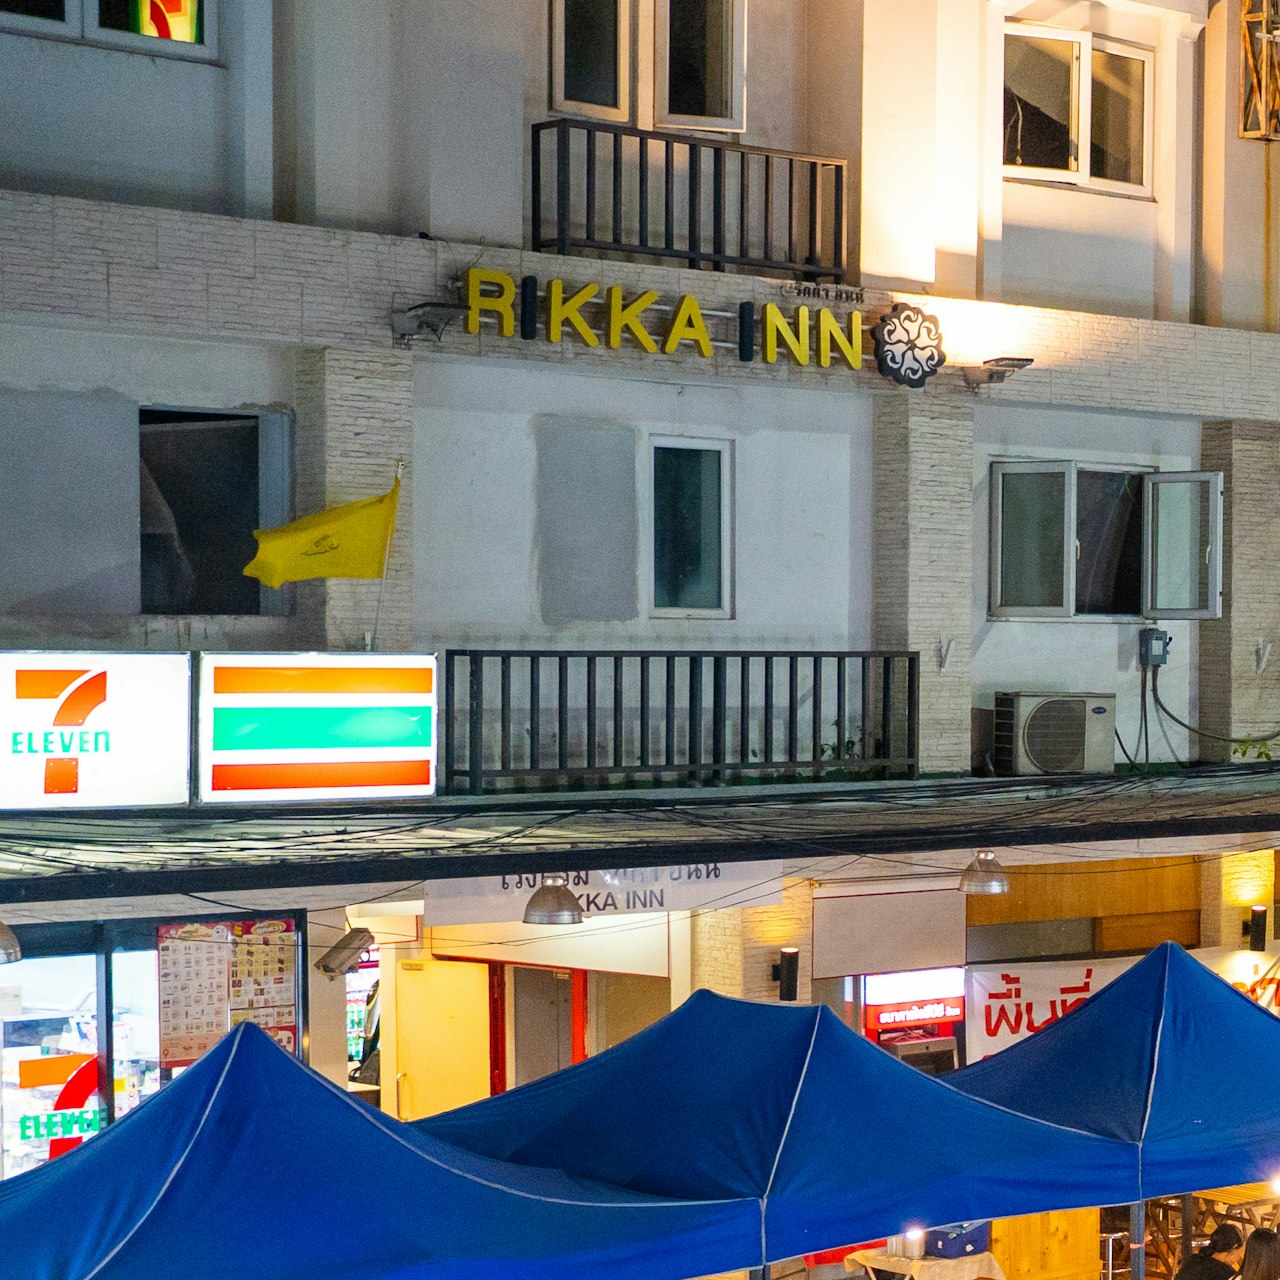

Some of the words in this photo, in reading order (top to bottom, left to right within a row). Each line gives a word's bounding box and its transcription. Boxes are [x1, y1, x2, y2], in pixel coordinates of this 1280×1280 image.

[467, 268, 713, 359] RIKKA
[738, 301, 863, 371] INN
[626, 889, 665, 910] INN
